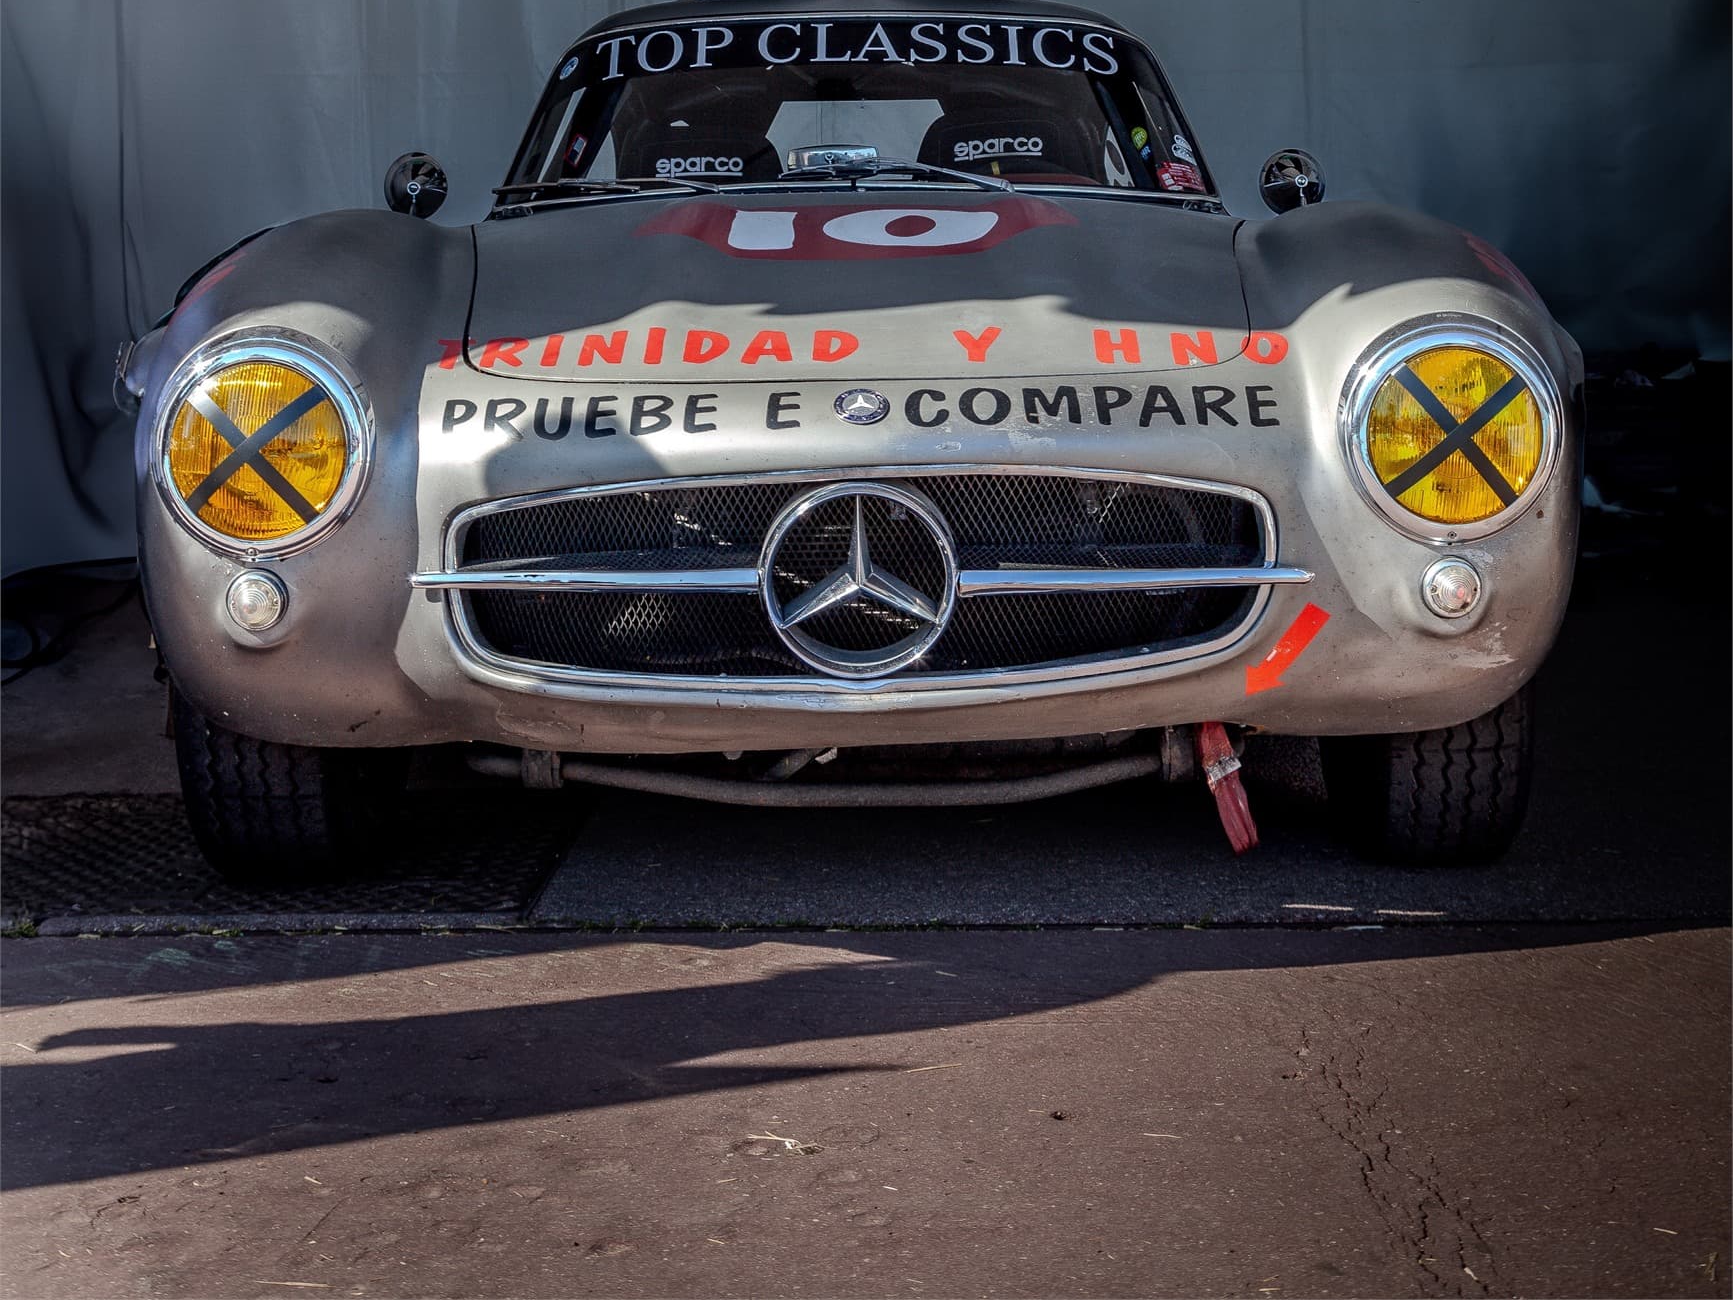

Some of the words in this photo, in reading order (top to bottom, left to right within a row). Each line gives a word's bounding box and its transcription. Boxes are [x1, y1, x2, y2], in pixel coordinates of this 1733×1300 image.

[596, 27, 733, 81] TOP
[758, 22, 1119, 75] CLASSICS
[655, 156, 744, 178] sparco
[954, 137, 1043, 161] sparco
[727, 209, 999, 251] 10
[438, 327, 859, 370] TRINIDAD
[953, 326, 1002, 362] Y
[442, 393, 719, 441] PRUEBE
[765, 391, 801, 430] E
[904, 385, 1280, 428] COMPARE
